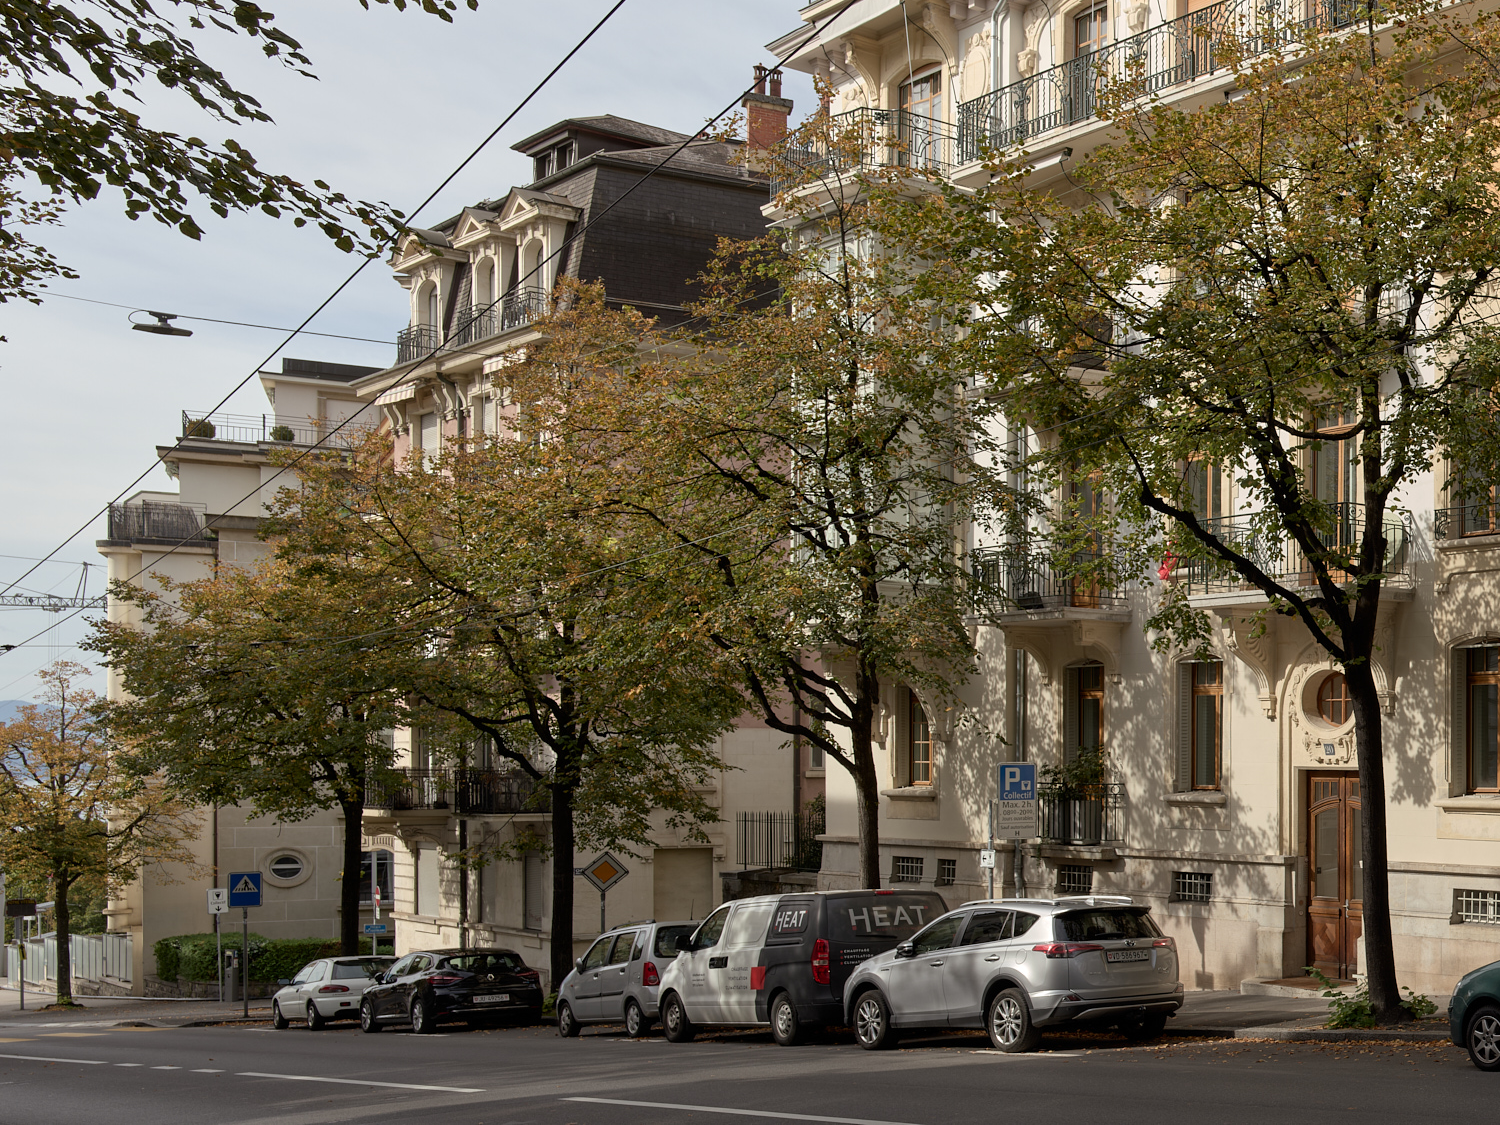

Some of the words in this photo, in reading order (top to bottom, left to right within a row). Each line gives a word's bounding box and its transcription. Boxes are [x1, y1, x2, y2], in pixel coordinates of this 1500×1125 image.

[1004, 767, 1020, 790] P
[1003, 791, 1032, 799] Collectif
[775, 910, 807, 932] HEAT
[848, 906, 926, 933] HEAT
